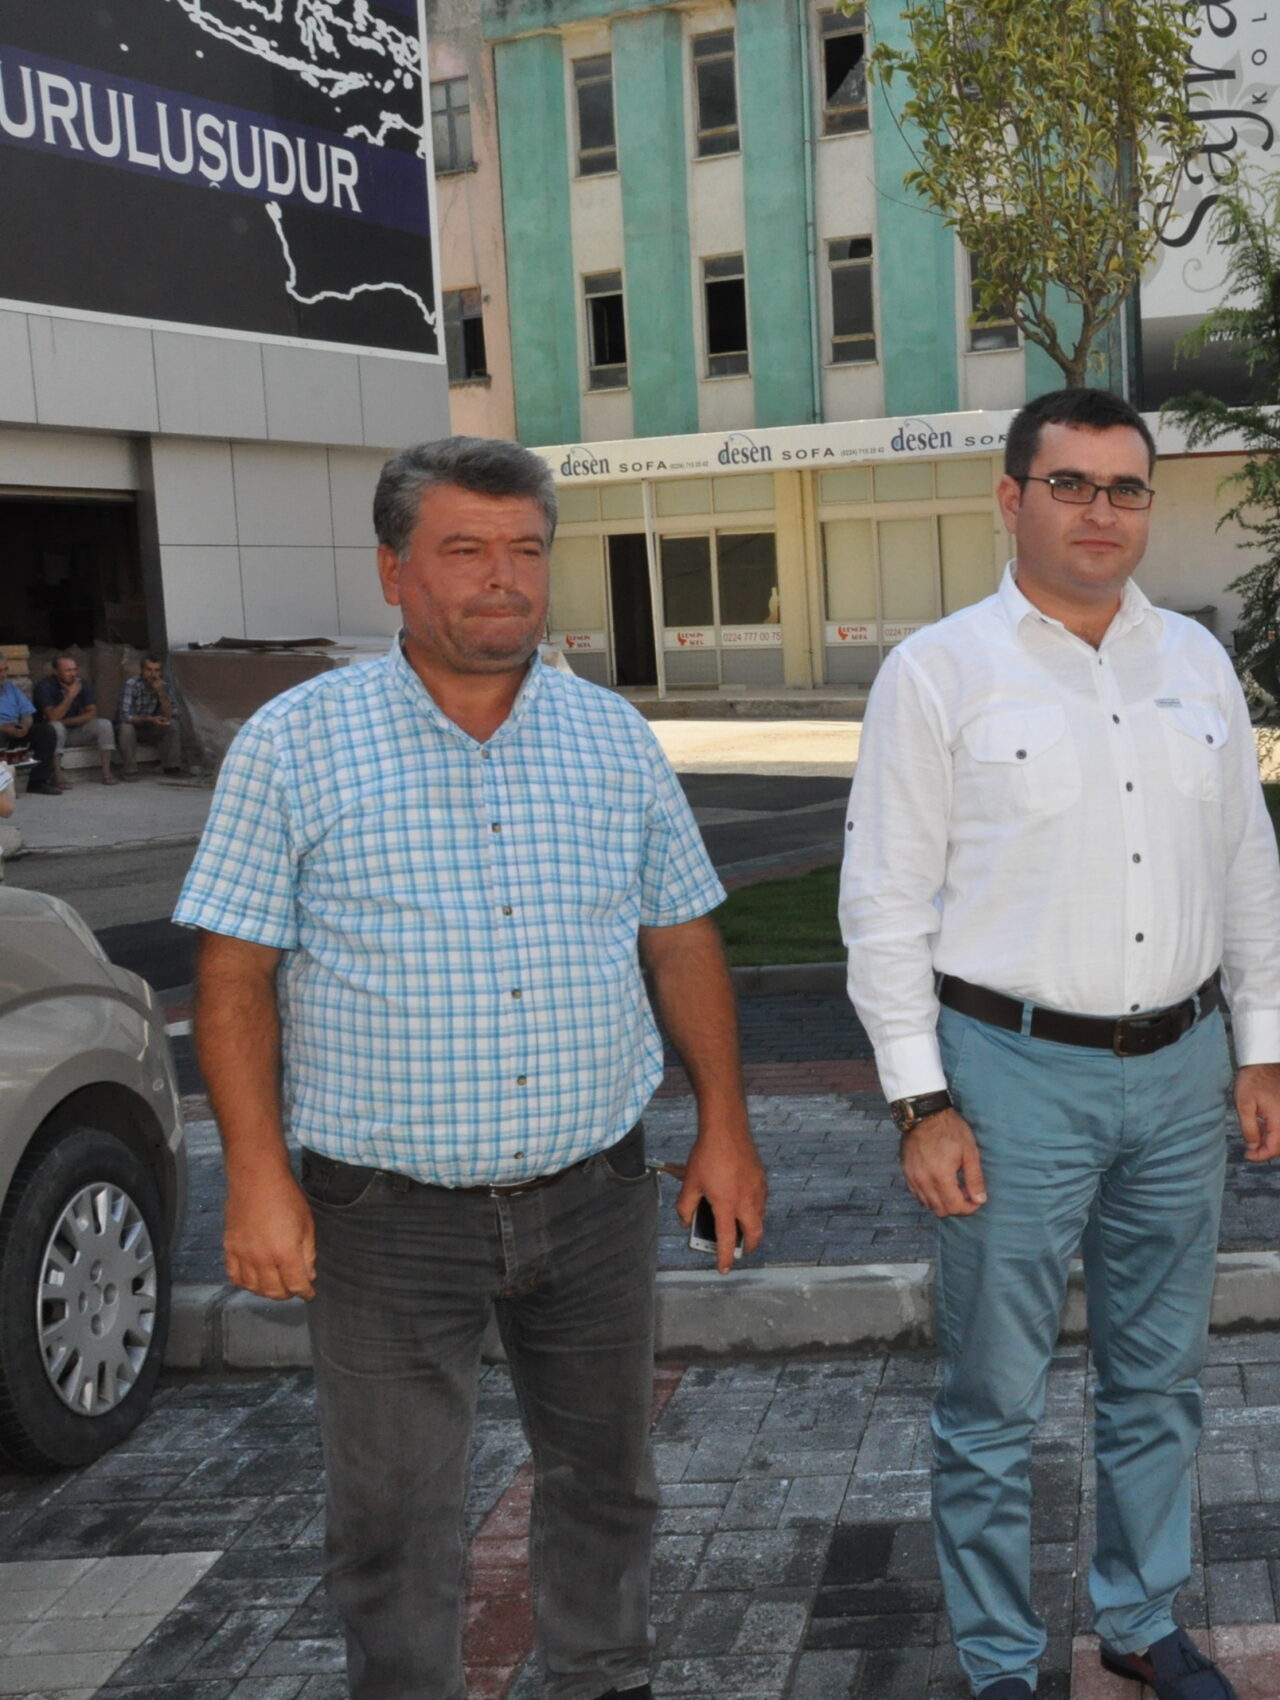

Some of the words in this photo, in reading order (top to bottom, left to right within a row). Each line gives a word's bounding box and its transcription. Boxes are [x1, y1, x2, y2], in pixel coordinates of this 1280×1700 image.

[890, 426, 953, 452] desen
[964, 433, 1009, 447] SOF
[560, 453, 611, 477] desen
[619, 460, 668, 473] SOFA
[717, 441, 773, 466] desen
[782, 447, 835, 461] SOFA
[723, 632, 742, 642] 0224
[743, 631, 758, 641] 777
[759, 631, 770, 641] 00
[772, 630, 782, 640] 75
